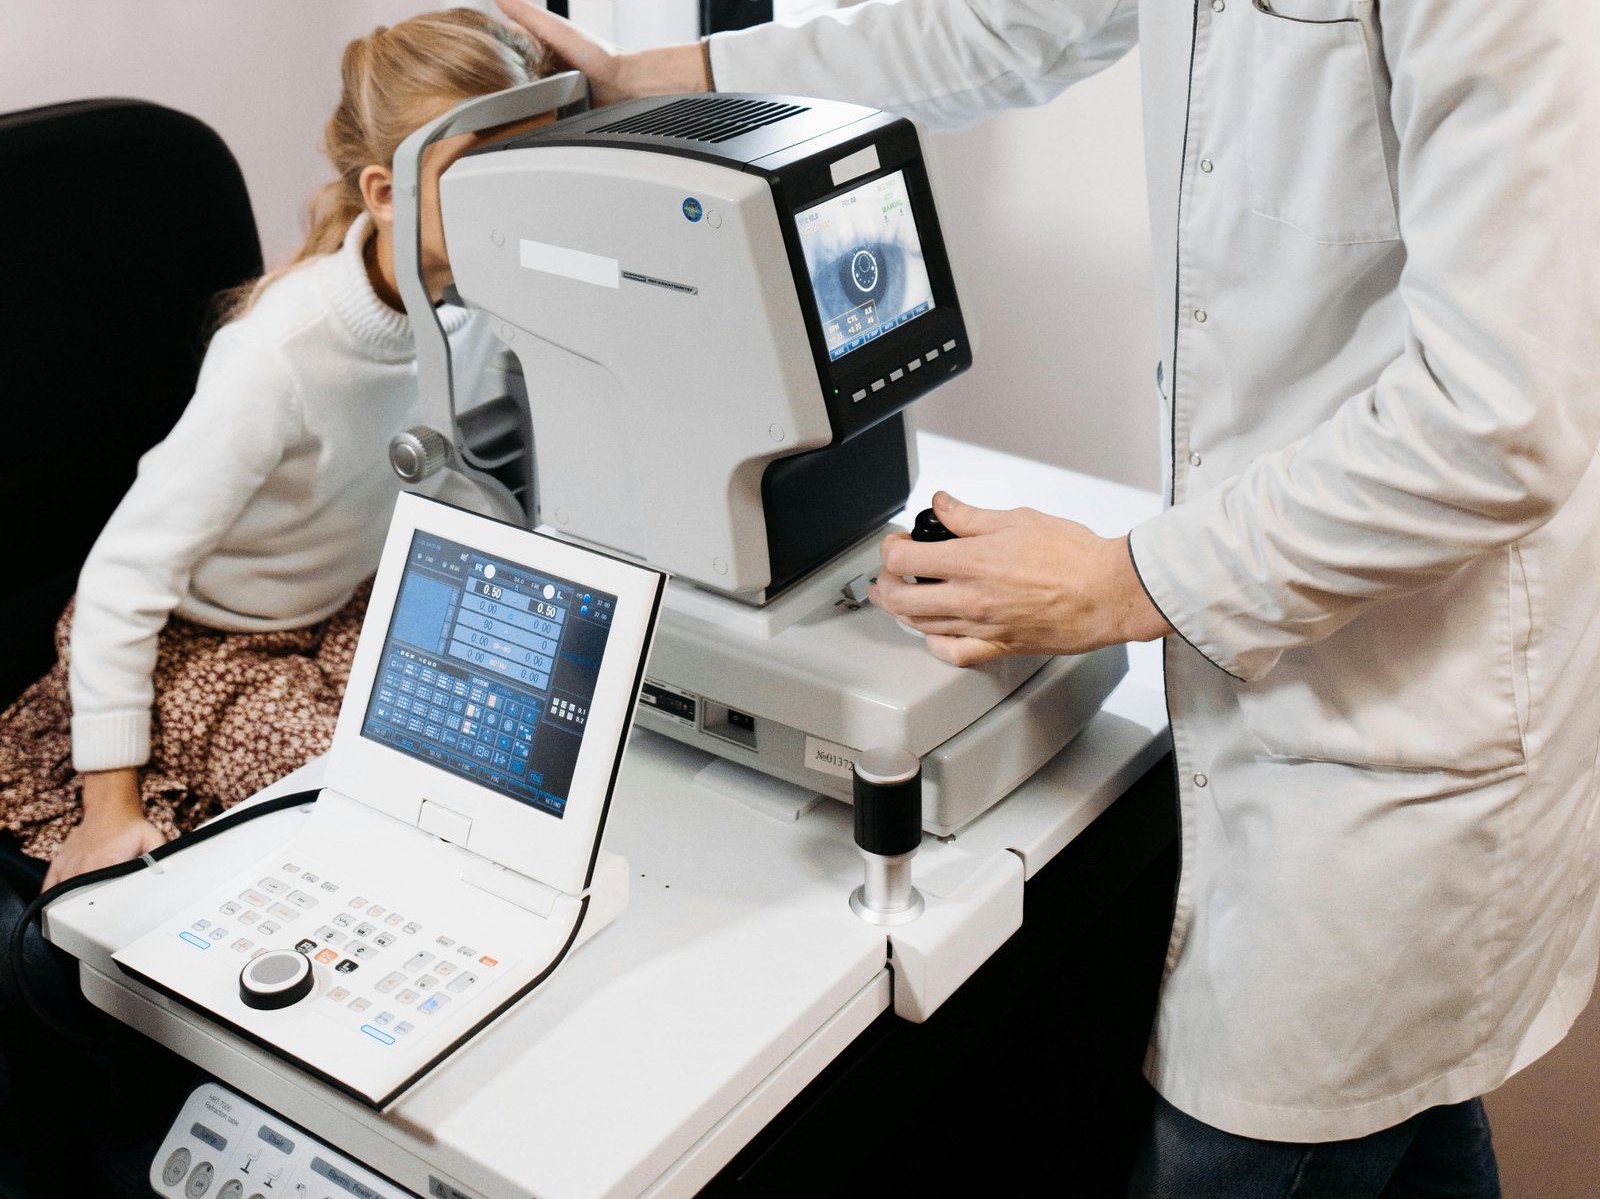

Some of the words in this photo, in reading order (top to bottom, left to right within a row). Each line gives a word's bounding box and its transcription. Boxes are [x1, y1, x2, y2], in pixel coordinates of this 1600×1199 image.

[474, 562, 483, 572] R
[482, 583, 502, 599] 0.50
[556, 590, 564, 599] L
[478, 600, 498, 615] 0.00
[536, 601, 556, 618] 0.50
[482, 618, 494, 631] 90
[532, 619, 552, 634] 0.00
[469, 632, 489, 647] 0.00
[465, 647, 485, 663] 0.00
[523, 652, 543, 667] 0.00
[519, 667, 539, 683] 0.00
[576, 706, 586, 716] 0.1
[574, 715, 584, 725] 0.2
